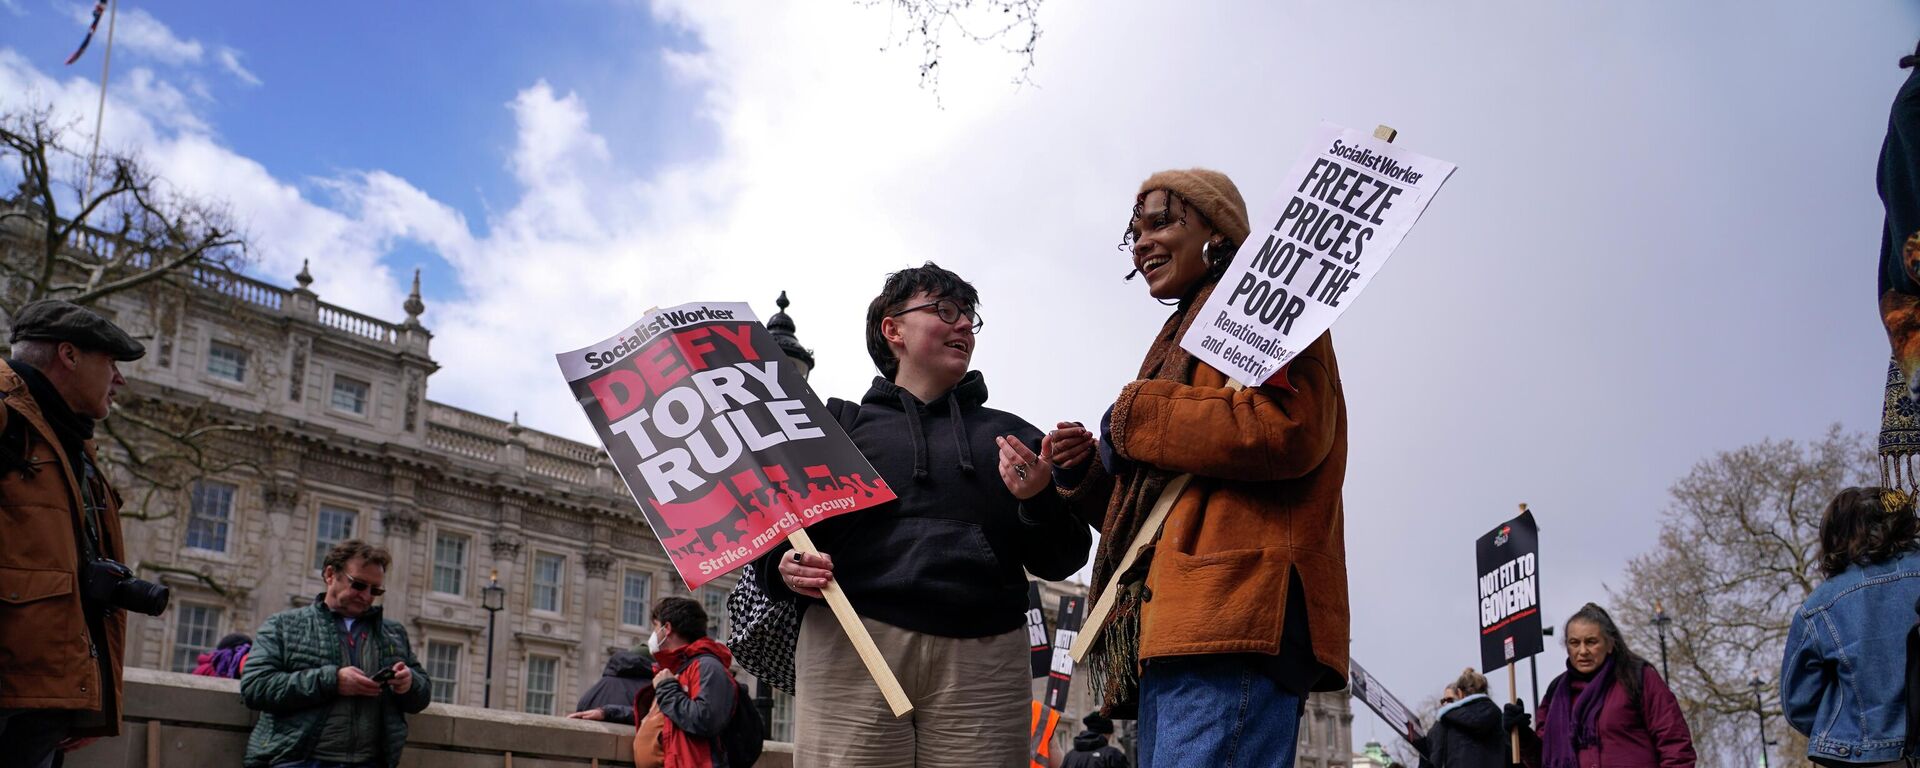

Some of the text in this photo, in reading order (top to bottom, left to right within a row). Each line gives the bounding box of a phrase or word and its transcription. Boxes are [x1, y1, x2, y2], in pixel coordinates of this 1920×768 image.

[1297, 157, 1403, 226] FREEZE
[1273, 196, 1374, 269] PRICES,
[1226, 271, 1306, 336] POOR
[1250, 234, 1360, 308] NOT THE
[1201, 334, 1227, 355] and
[1214, 310, 1287, 361] Renationalise
[588, 324, 761, 422] DEFY
[609, 360, 789, 460] TORY
[637, 399, 826, 506] RULE
[698, 494, 856, 575] Strike, march, occupy
[1479, 551, 1536, 599] NOT FIT TO
[1480, 574, 1537, 628] GOVERN
